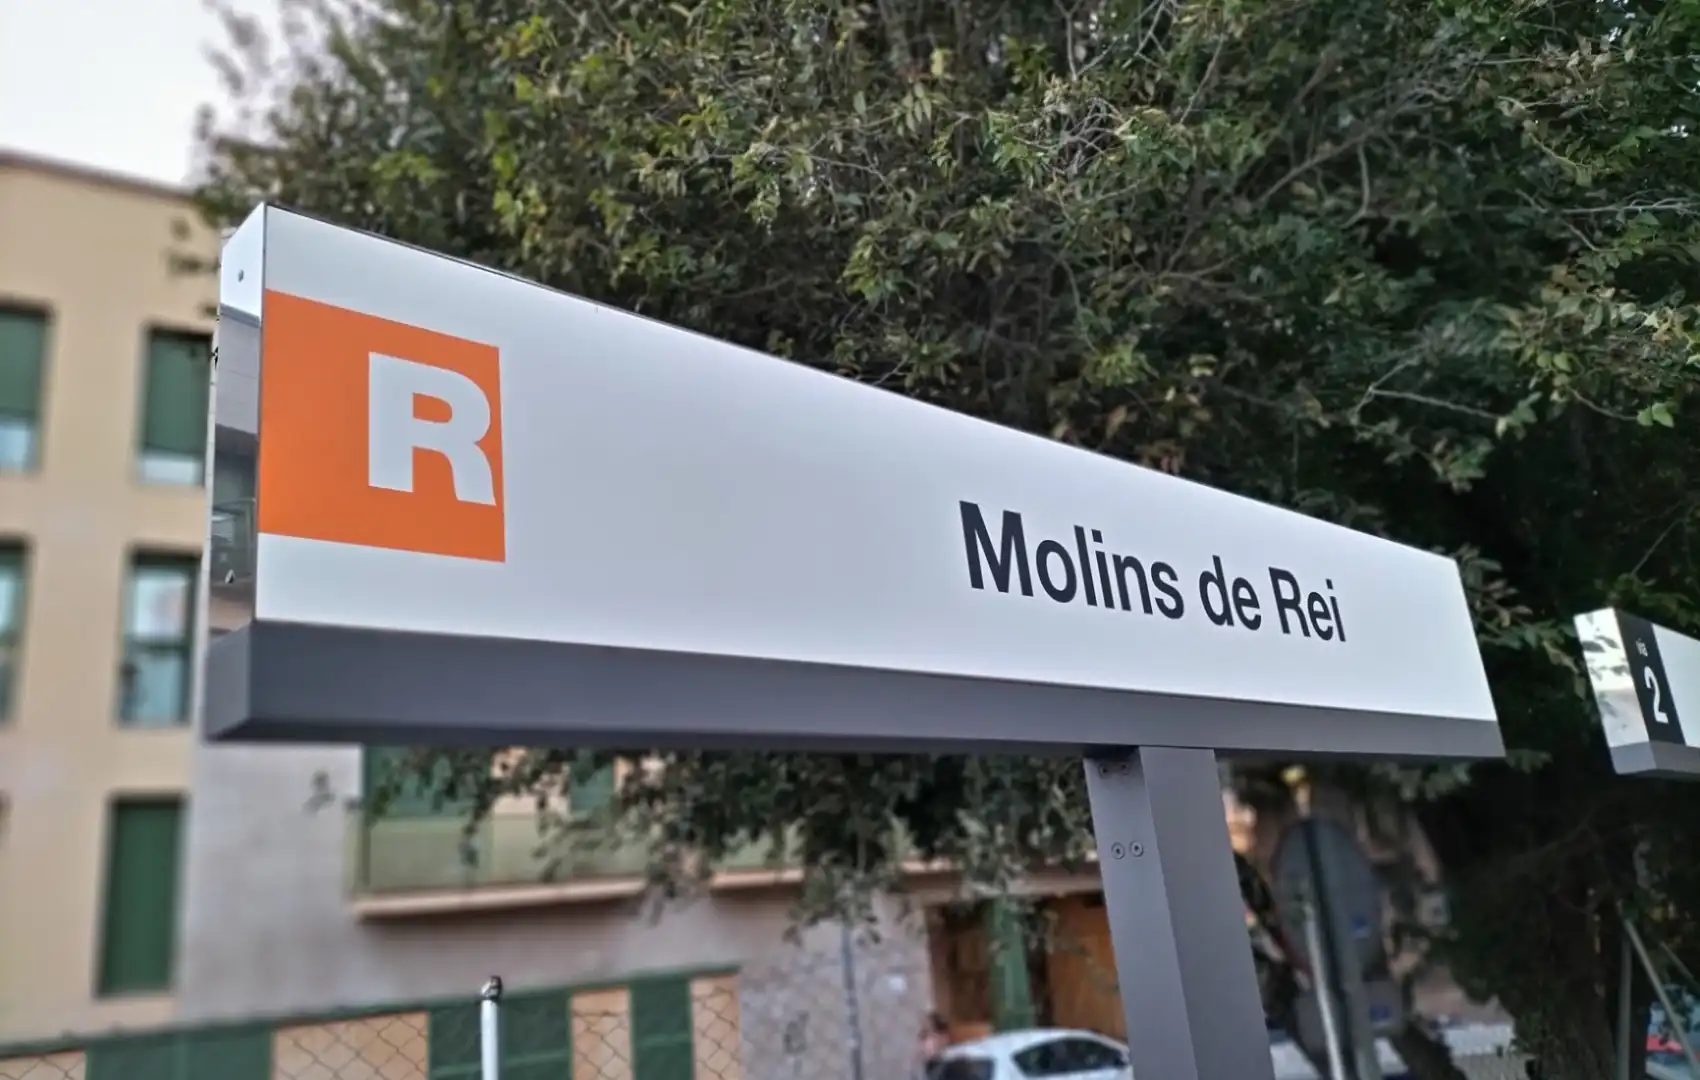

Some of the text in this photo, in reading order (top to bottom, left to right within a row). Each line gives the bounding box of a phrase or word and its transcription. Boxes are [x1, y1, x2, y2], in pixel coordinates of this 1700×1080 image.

[368, 352, 497, 506] R
[959, 500, 1347, 642] Molins de Rei
[1644, 666, 1669, 724] 2
